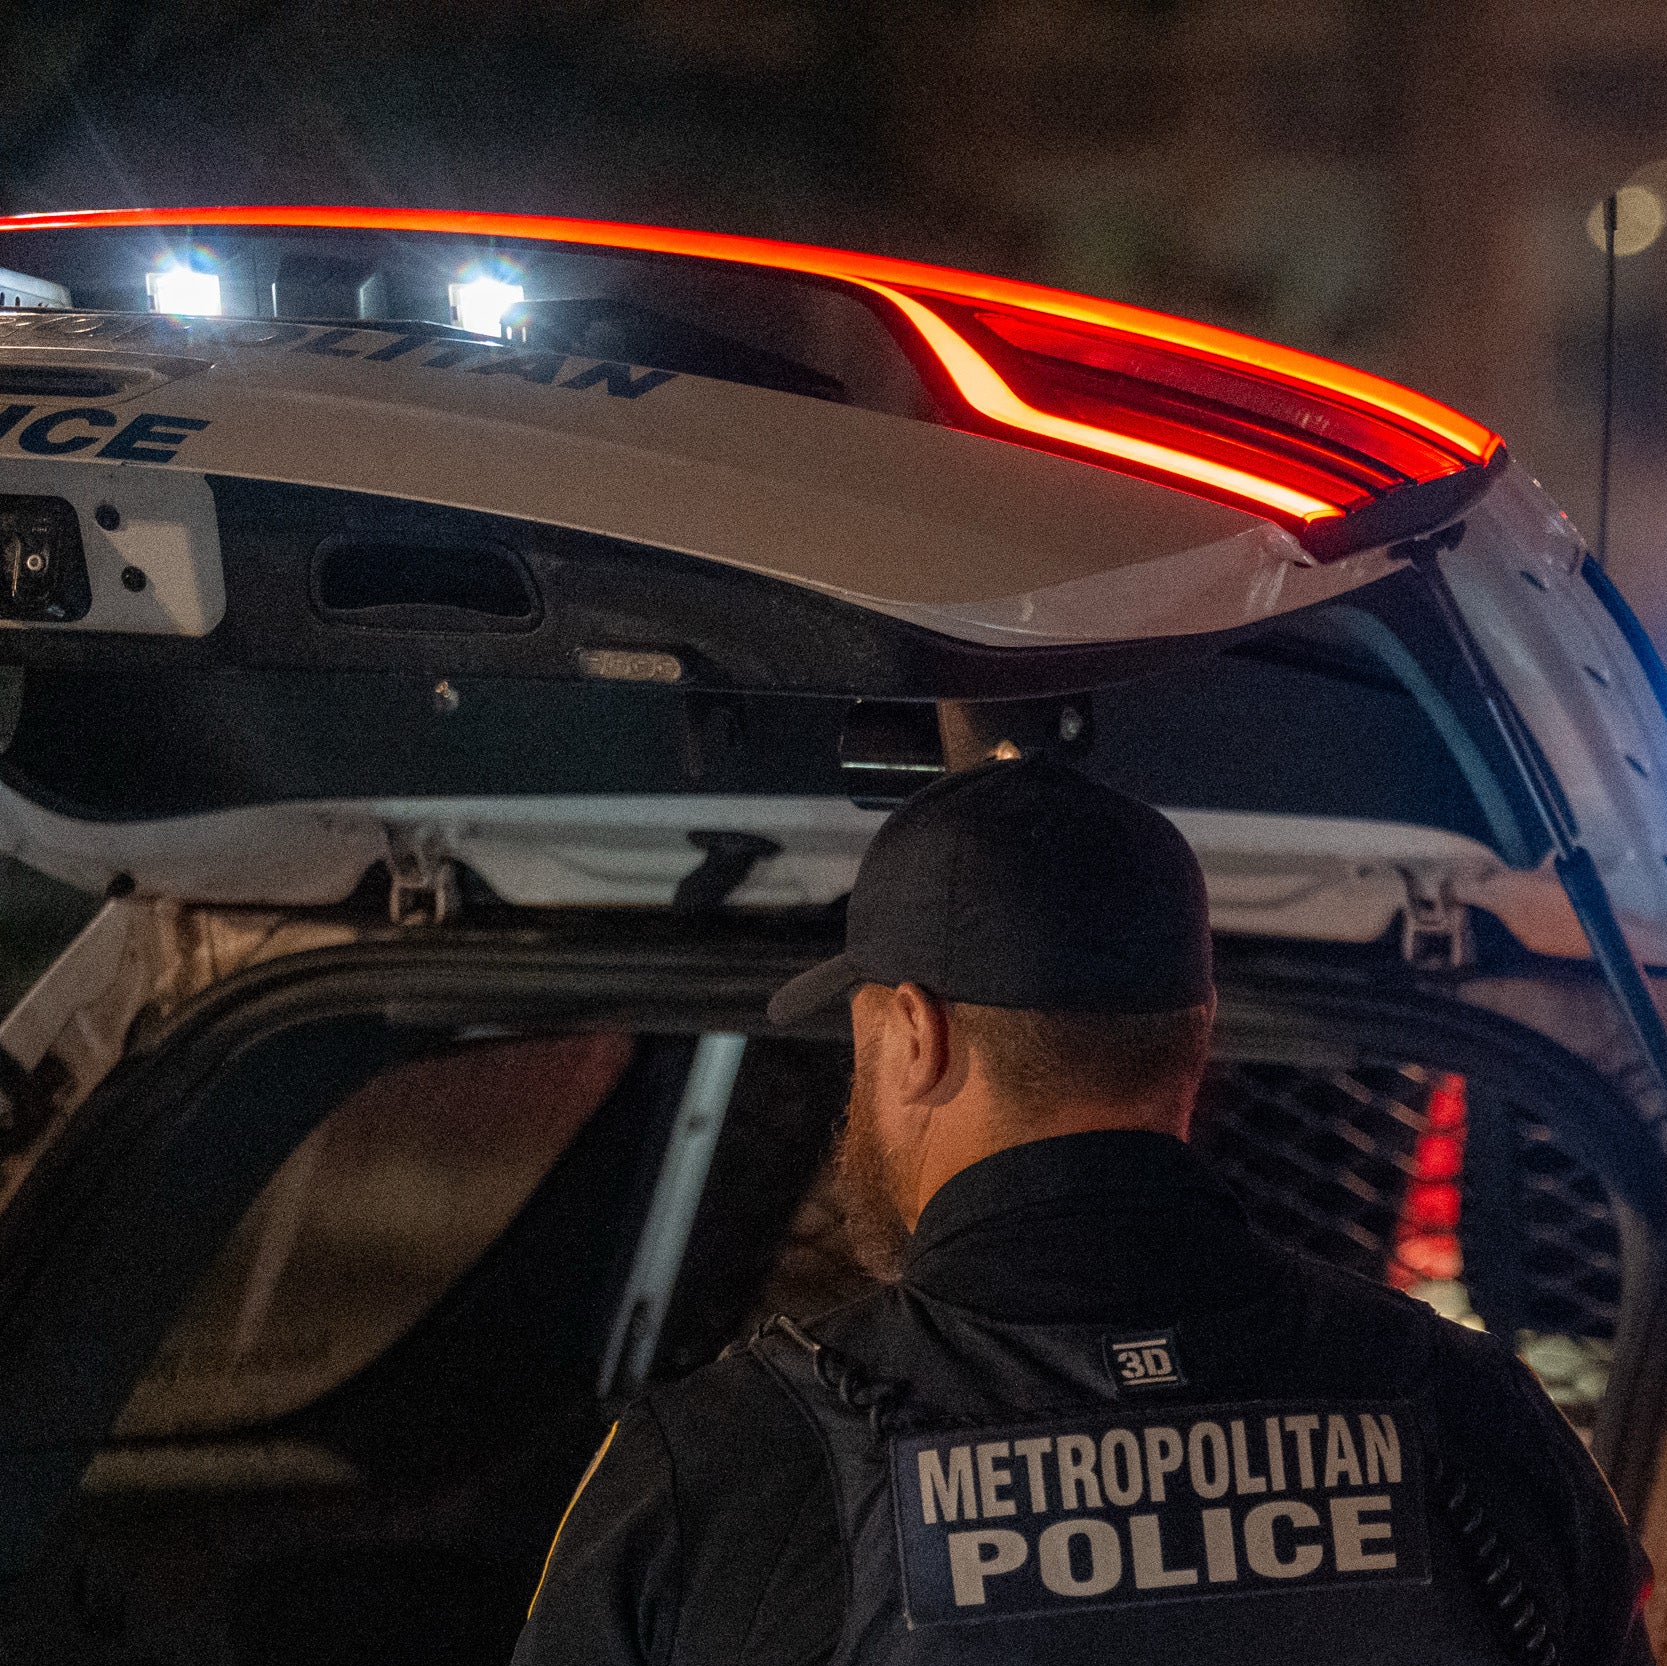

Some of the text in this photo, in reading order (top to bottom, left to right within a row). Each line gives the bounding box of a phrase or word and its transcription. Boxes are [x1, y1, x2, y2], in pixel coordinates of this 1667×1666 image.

[1117, 1347, 1174, 1380] 3D
[917, 1413, 1402, 1524] METROPOLITAN
[948, 1495, 1397, 1607] POLICE
